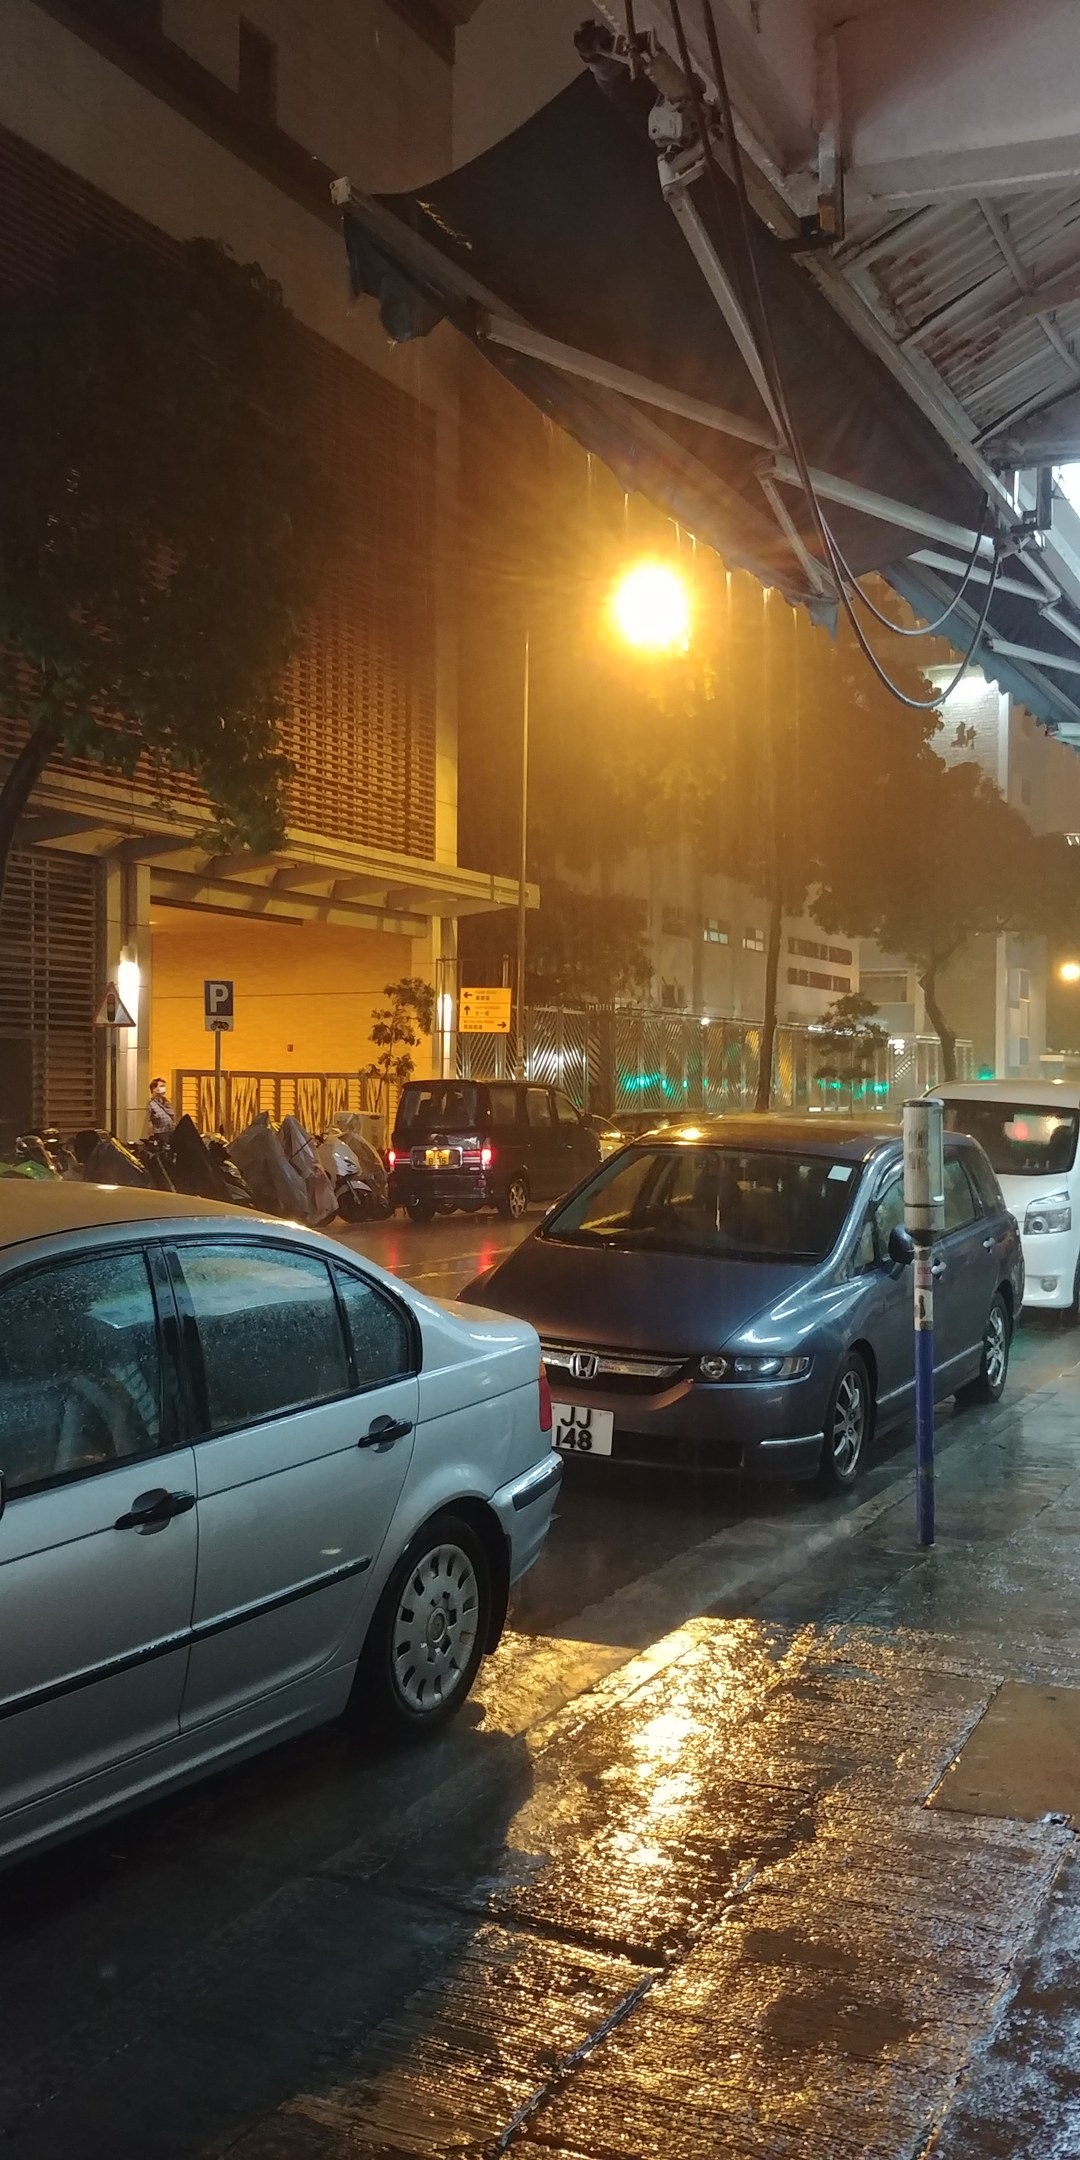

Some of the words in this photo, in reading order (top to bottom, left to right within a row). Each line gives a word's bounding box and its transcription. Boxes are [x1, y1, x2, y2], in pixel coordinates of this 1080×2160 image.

[209, 983, 229, 1013] P
[560, 1406, 591, 1429] JJ
[555, 1425, 592, 1450] 148
